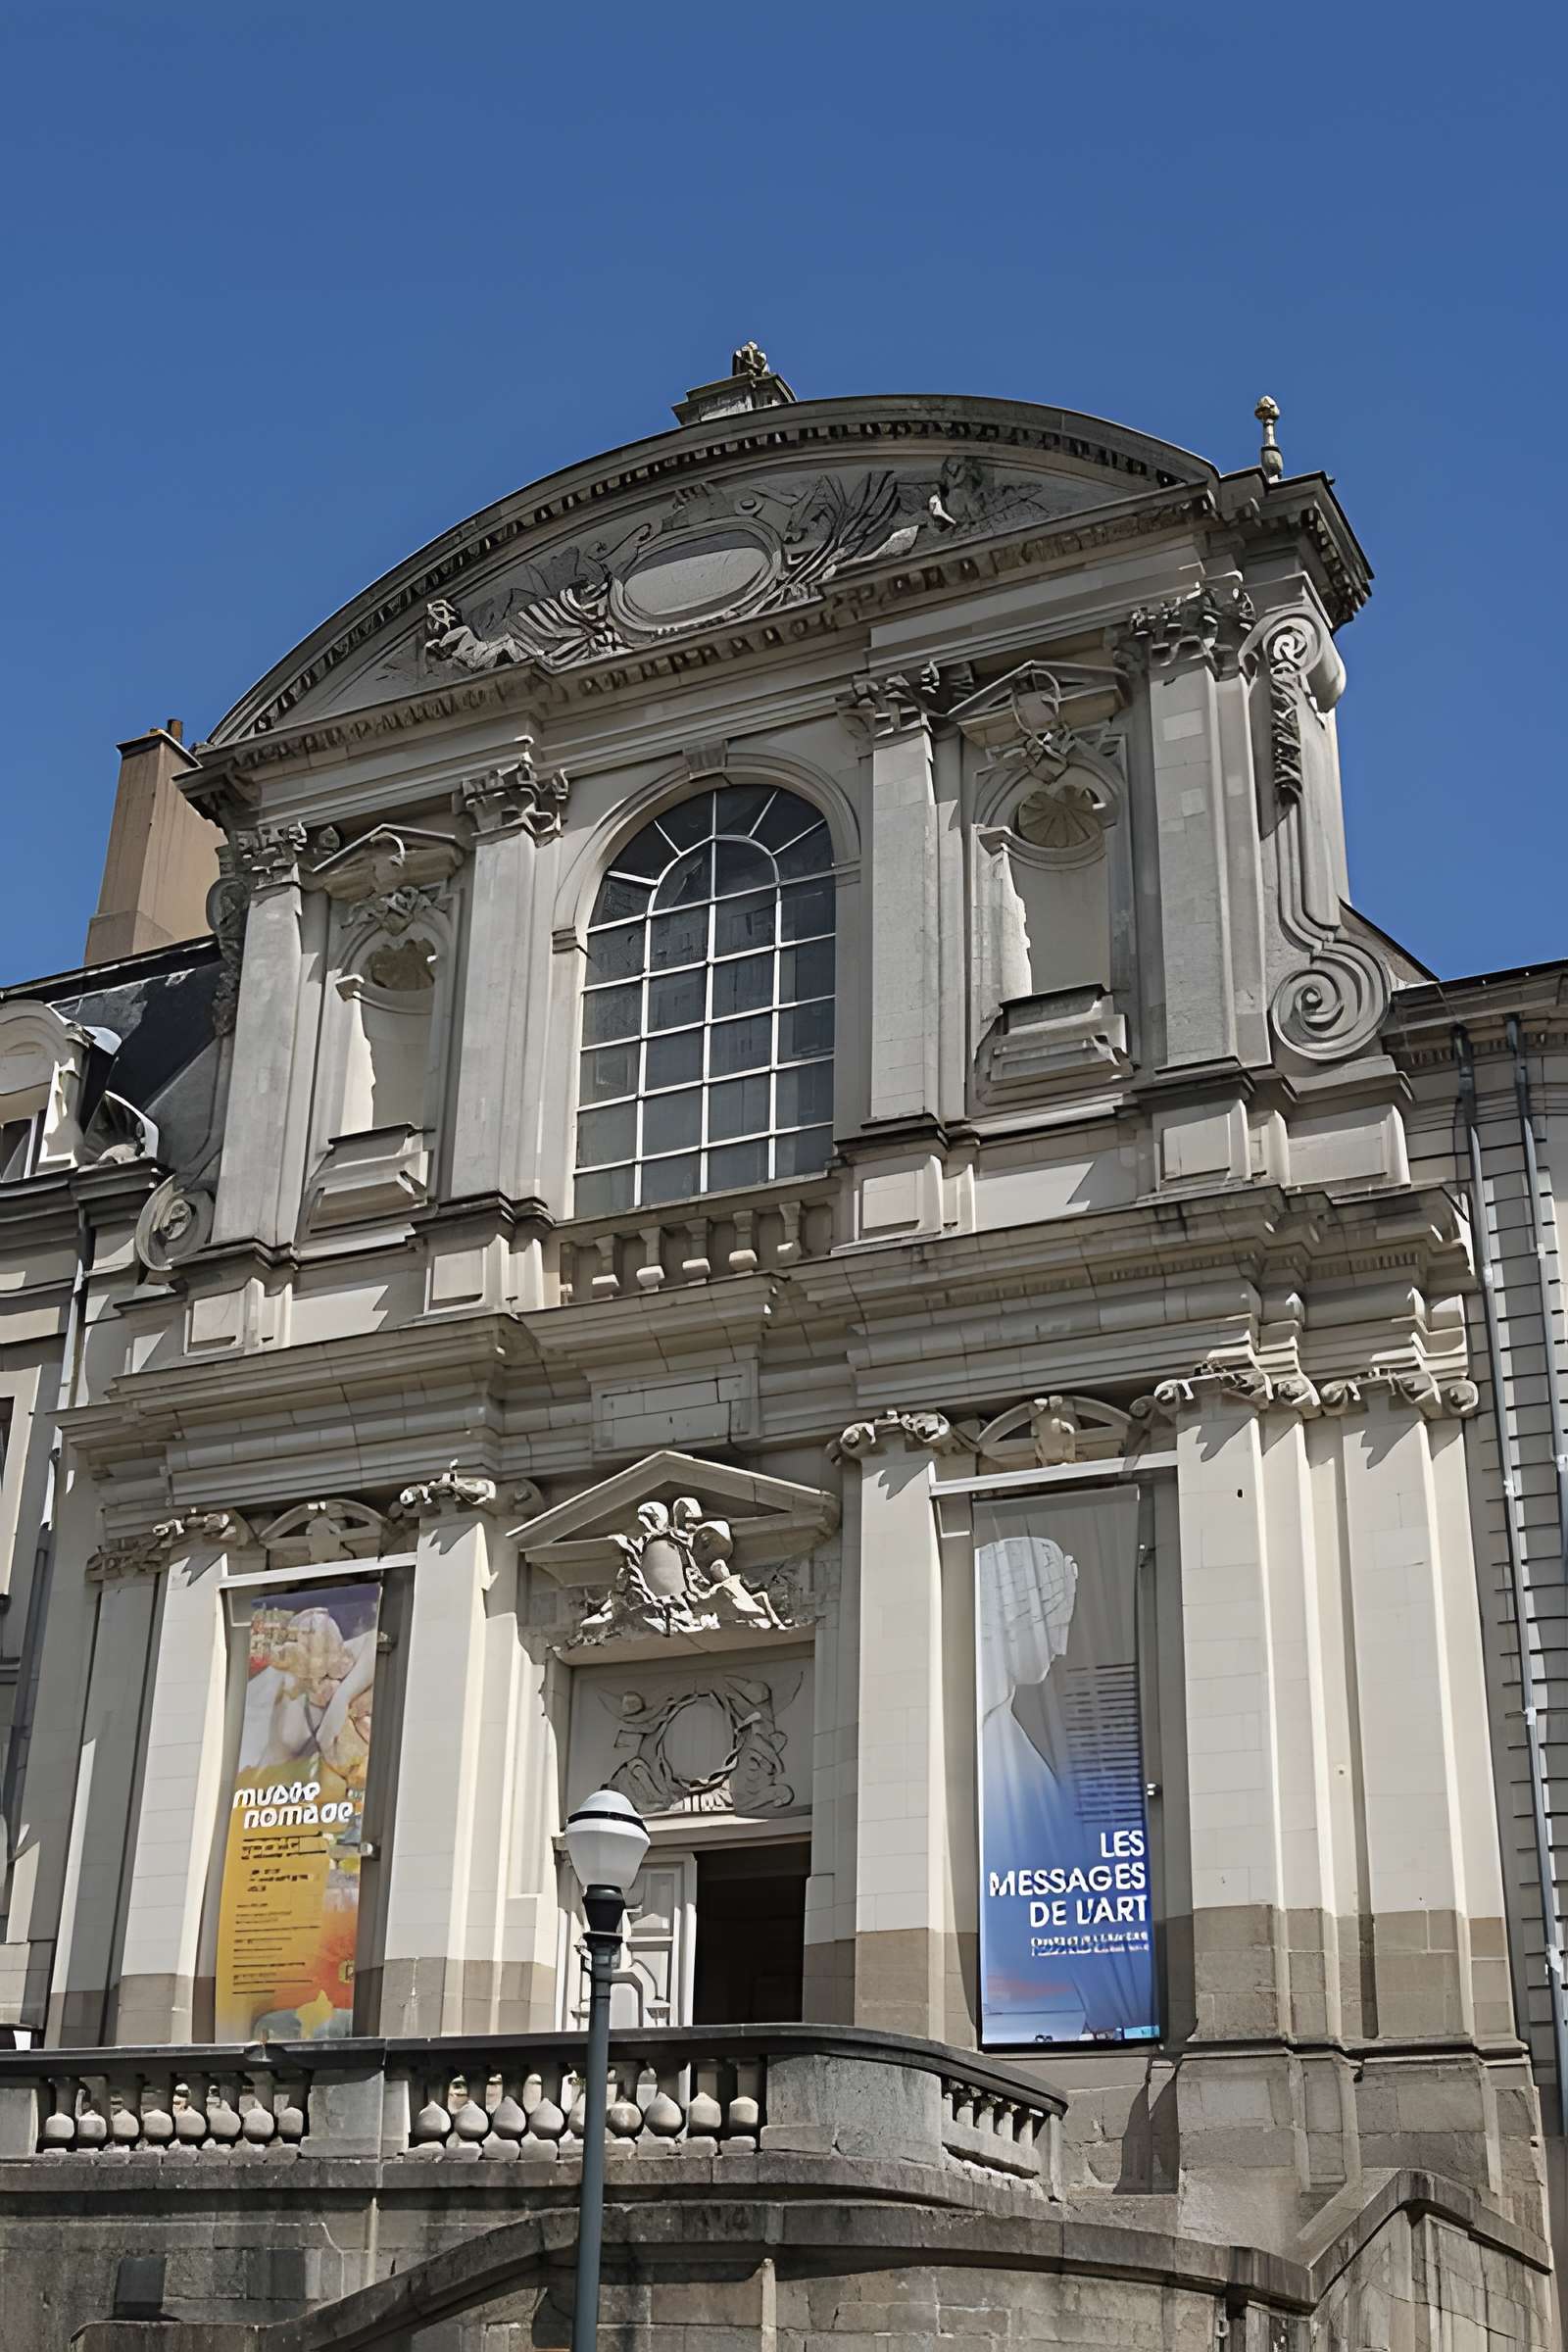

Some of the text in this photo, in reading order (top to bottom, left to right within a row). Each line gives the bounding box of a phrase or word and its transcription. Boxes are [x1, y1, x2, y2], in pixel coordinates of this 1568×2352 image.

[1100, 1830, 1145, 1858] LES
[989, 1862, 1146, 1897] MESSAGES
[1030, 1894, 1148, 1928] DE L'ART
